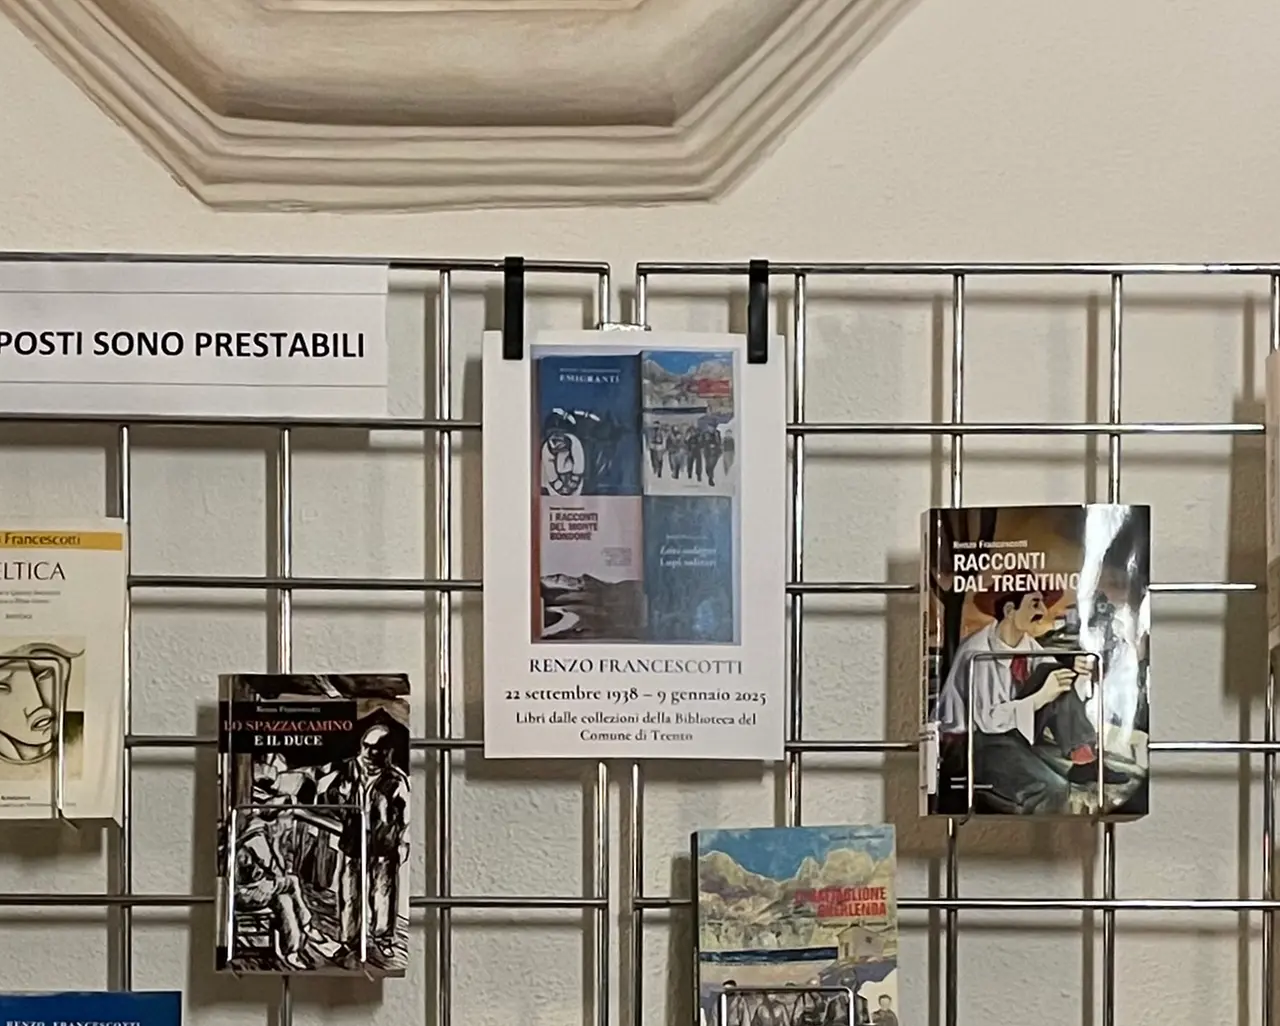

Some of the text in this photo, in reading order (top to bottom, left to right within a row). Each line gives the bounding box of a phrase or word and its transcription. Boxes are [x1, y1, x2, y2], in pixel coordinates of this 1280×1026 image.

[92, 331, 185, 357] SONO
[195, 332, 365, 358] PRESTABILI
[4, 532, 80, 546] Francescotti
[953, 552, 1045, 572] RACCONTI
[953, 573, 1082, 593] DAL TRENTINO
[529, 658, 743, 675] RENZO FRANCESCOTTI
[505, 689, 520, 701] 22
[525, 685, 601, 701] settembre
[607, 688, 639, 705] 1938
[657, 691, 666, 704] 9
[671, 689, 730, 705] gennaio
[735, 691, 767, 706] 2025
[516, 711, 756, 725] Libri dalle collezioni della Biblioteca del
[245, 720, 353, 732] SPAZZACAMINO
[254, 735, 323, 746] E IL DUCE
[580, 729, 693, 742] Comune di Trento
